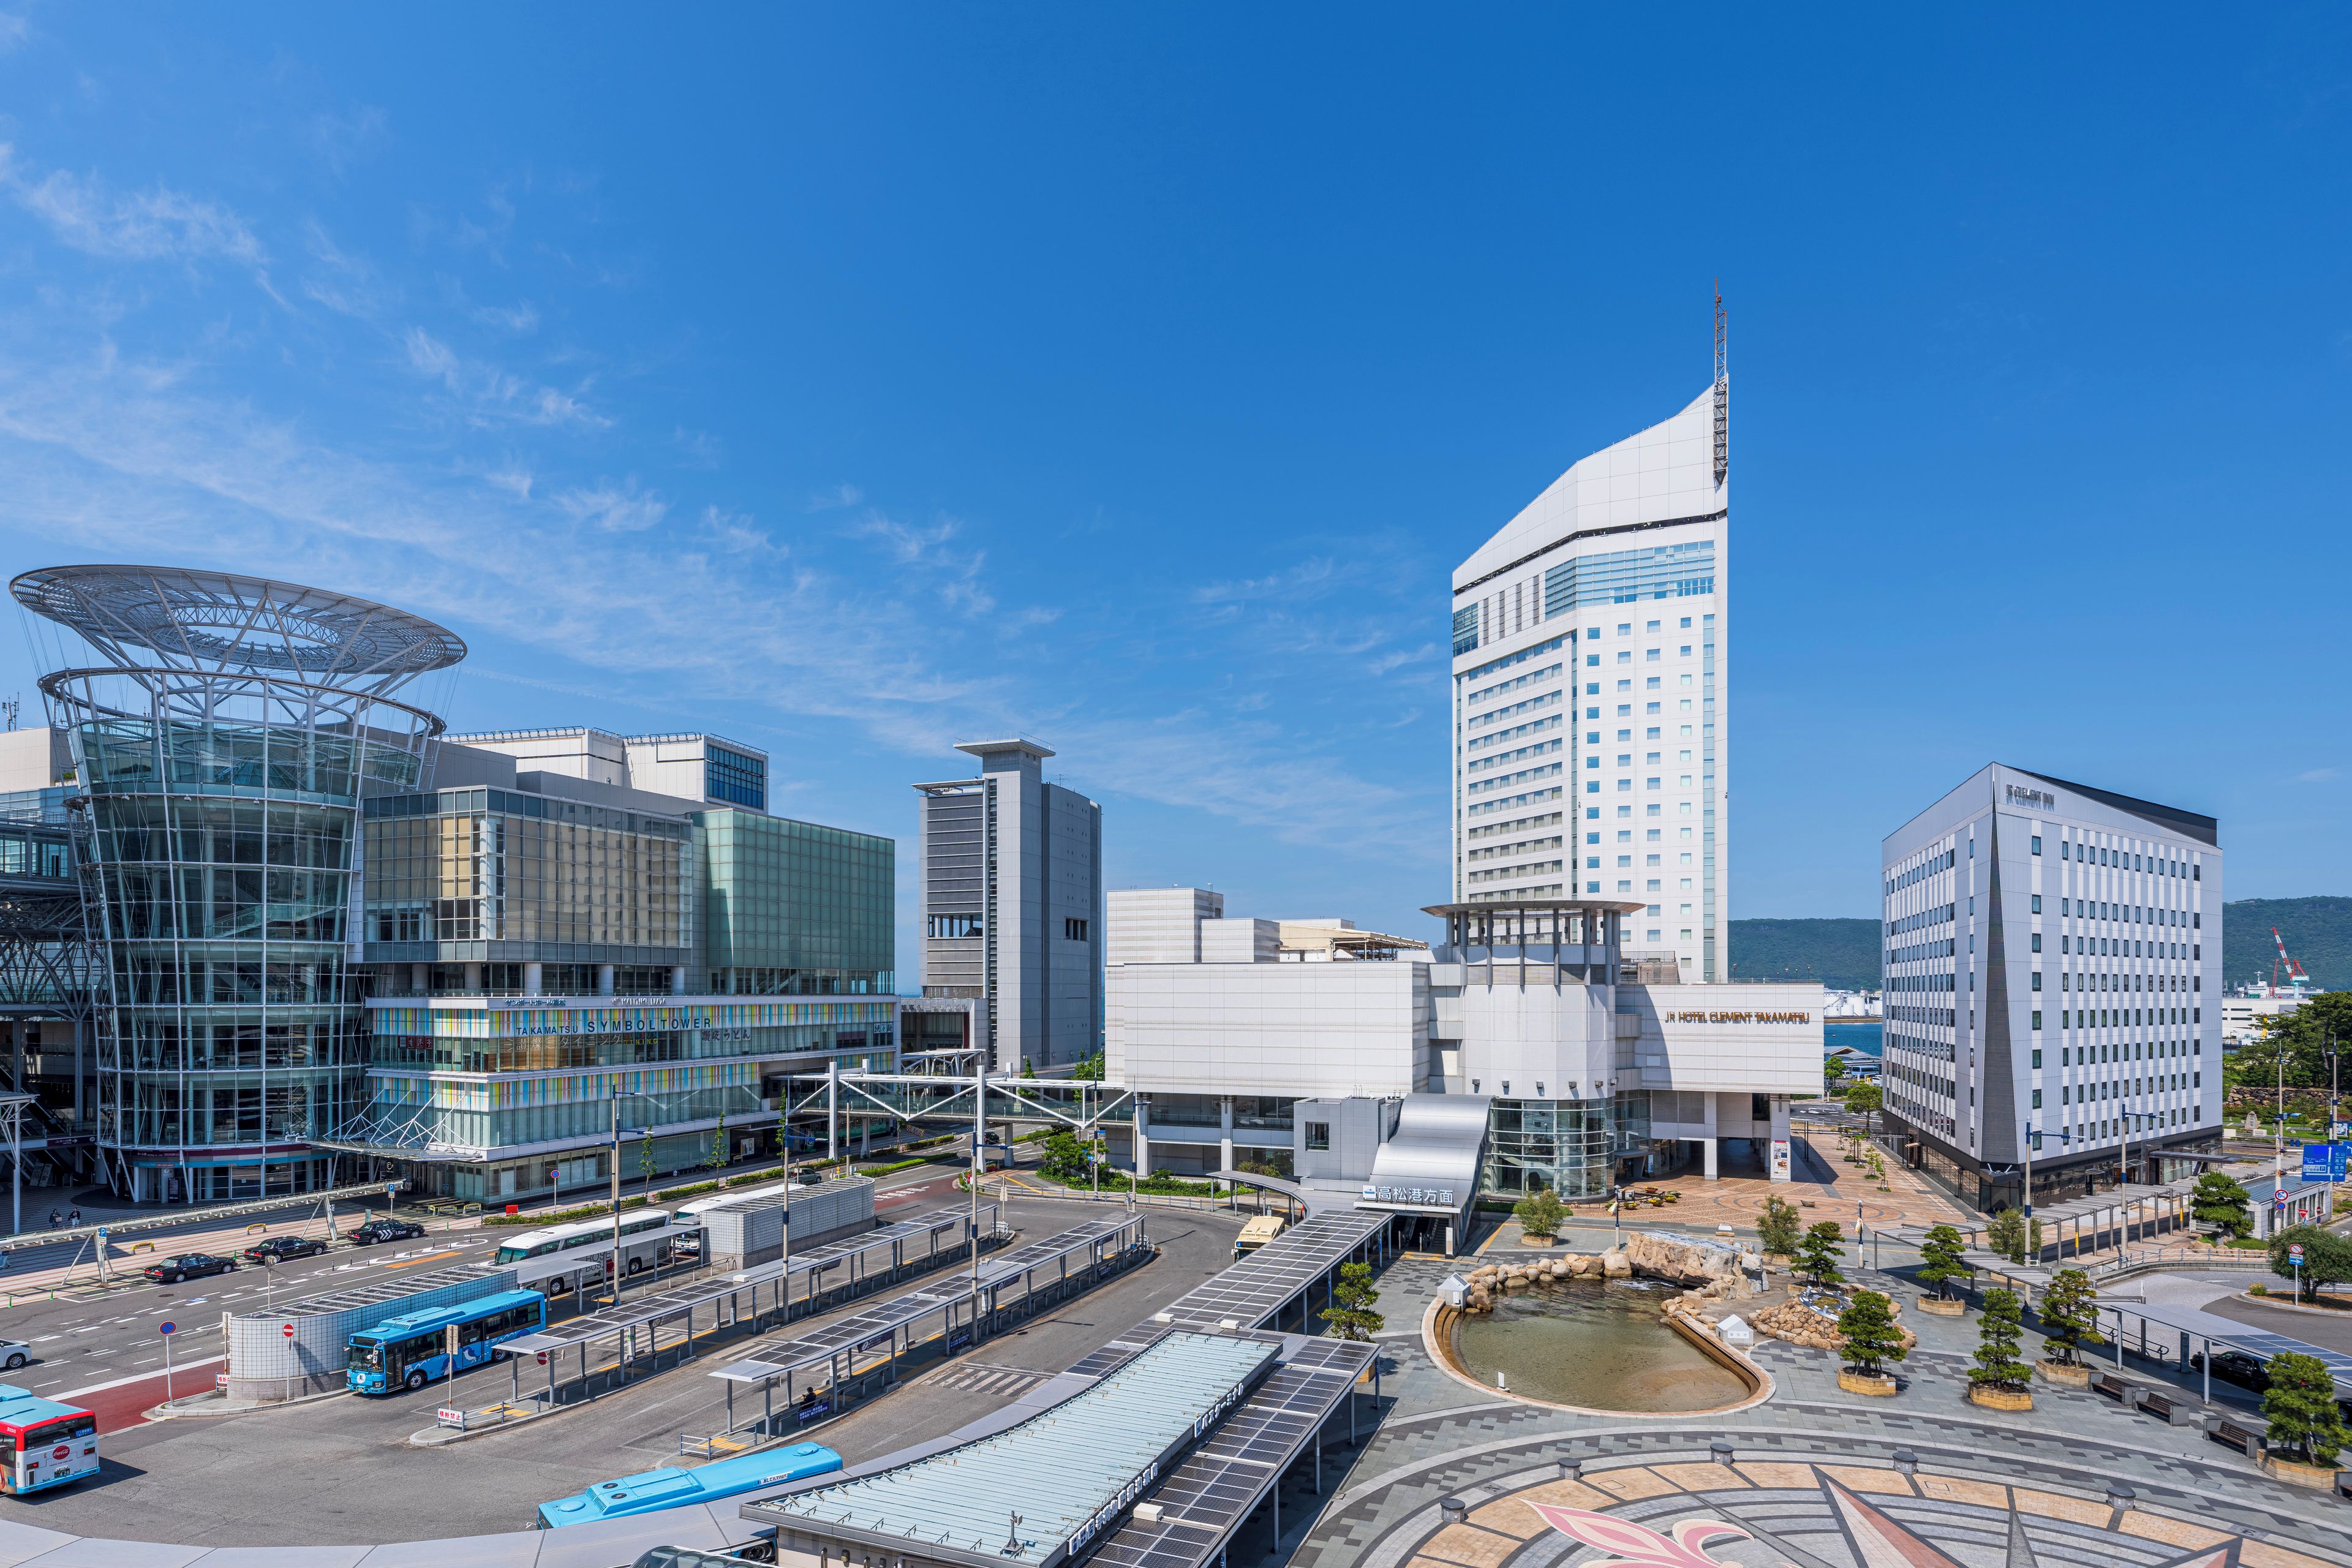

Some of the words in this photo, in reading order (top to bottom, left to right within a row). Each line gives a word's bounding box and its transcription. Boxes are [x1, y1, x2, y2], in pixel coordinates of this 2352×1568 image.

[1665, 1011, 1675, 1022] JR
[1678, 1011, 1708, 1022] HOTEL
[1709, 1011, 1753, 1023] CLEMENT
[1754, 1012, 1810, 1023] TAKAMATSU
[516, 1026, 578, 1035] TAKAMATSU
[587, 1020, 655, 1033] SYMBOL
[661, 1018, 711, 1030] TOWER
[701, 1028, 750, 1042] 讃岐うどん
[1378, 1186, 1453, 1204] 高松港方面
[586, 1251, 611, 1262] ROSE
[586, 1264, 601, 1273] BUS
[1202, 1382, 1244, 1430] バスターミナル
[439, 1411, 461, 1421] 横断禁止
